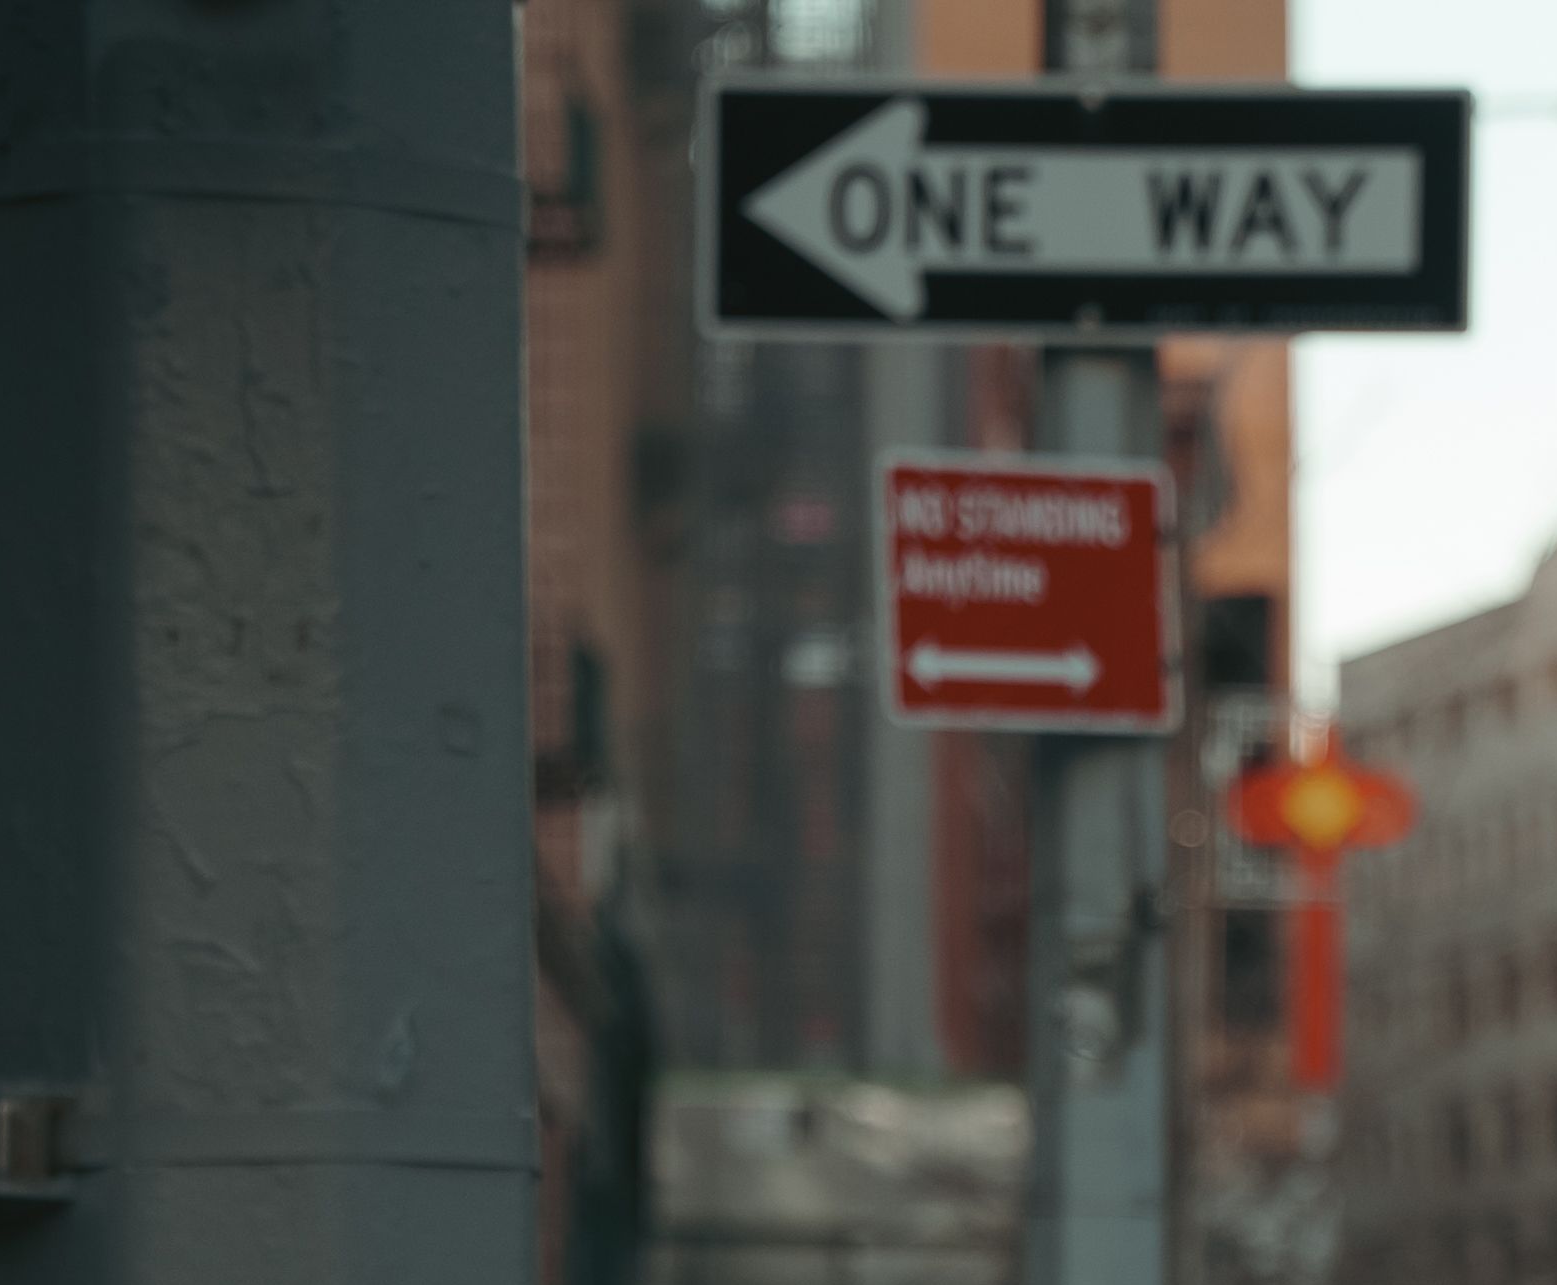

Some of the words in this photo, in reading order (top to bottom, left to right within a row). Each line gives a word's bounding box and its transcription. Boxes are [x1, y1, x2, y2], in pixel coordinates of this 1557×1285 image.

[826, 161, 1035, 257] ONE
[1145, 166, 1371, 260] WAY
[899, 486, 947, 541] NO
[955, 486, 1129, 550] STANDING
[902, 551, 1046, 609] Anytime
